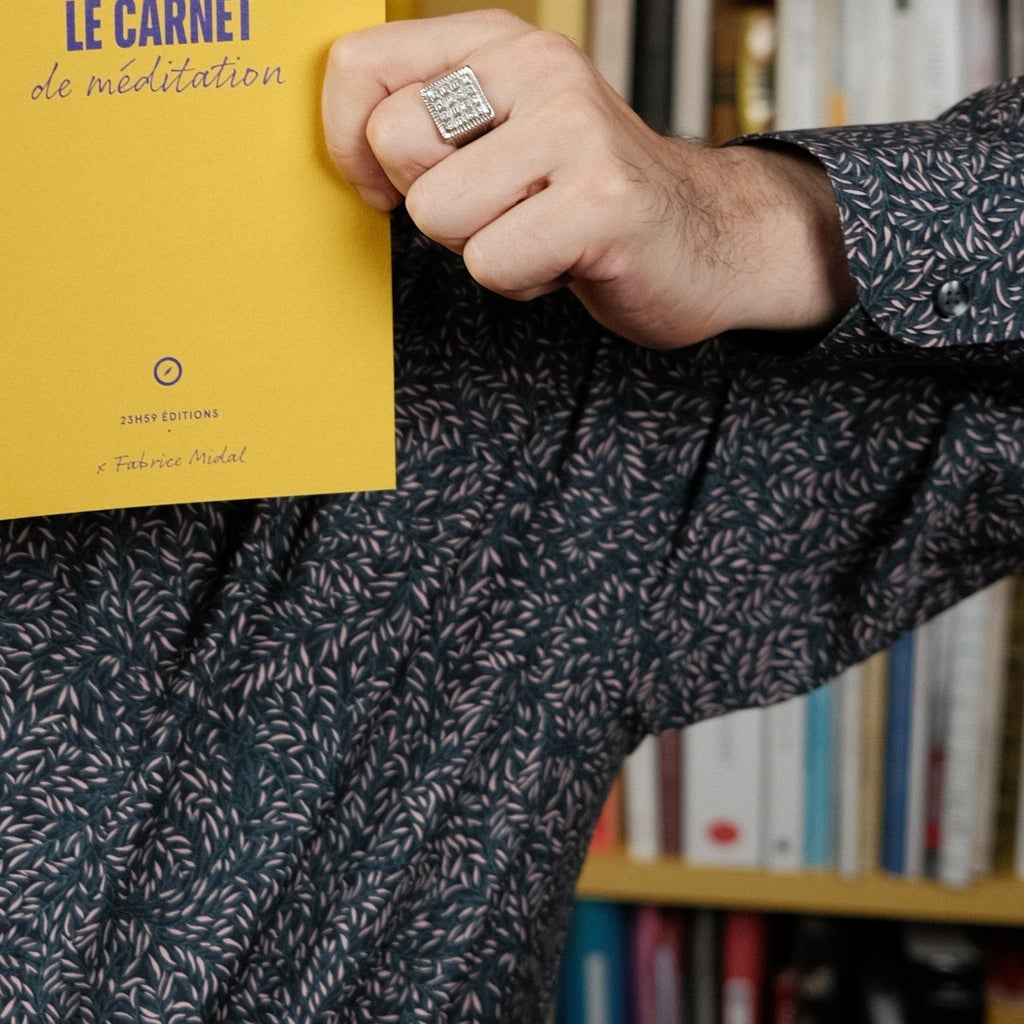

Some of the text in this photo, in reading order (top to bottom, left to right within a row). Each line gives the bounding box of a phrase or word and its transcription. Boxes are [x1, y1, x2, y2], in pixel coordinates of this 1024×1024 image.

[31, 55, 286, 101] de méditation
[119, 408, 219, 426] 23H59 ÉDITIONS
[114, 450, 182, 473] Fabrice
[188, 444, 248, 466] Midal
